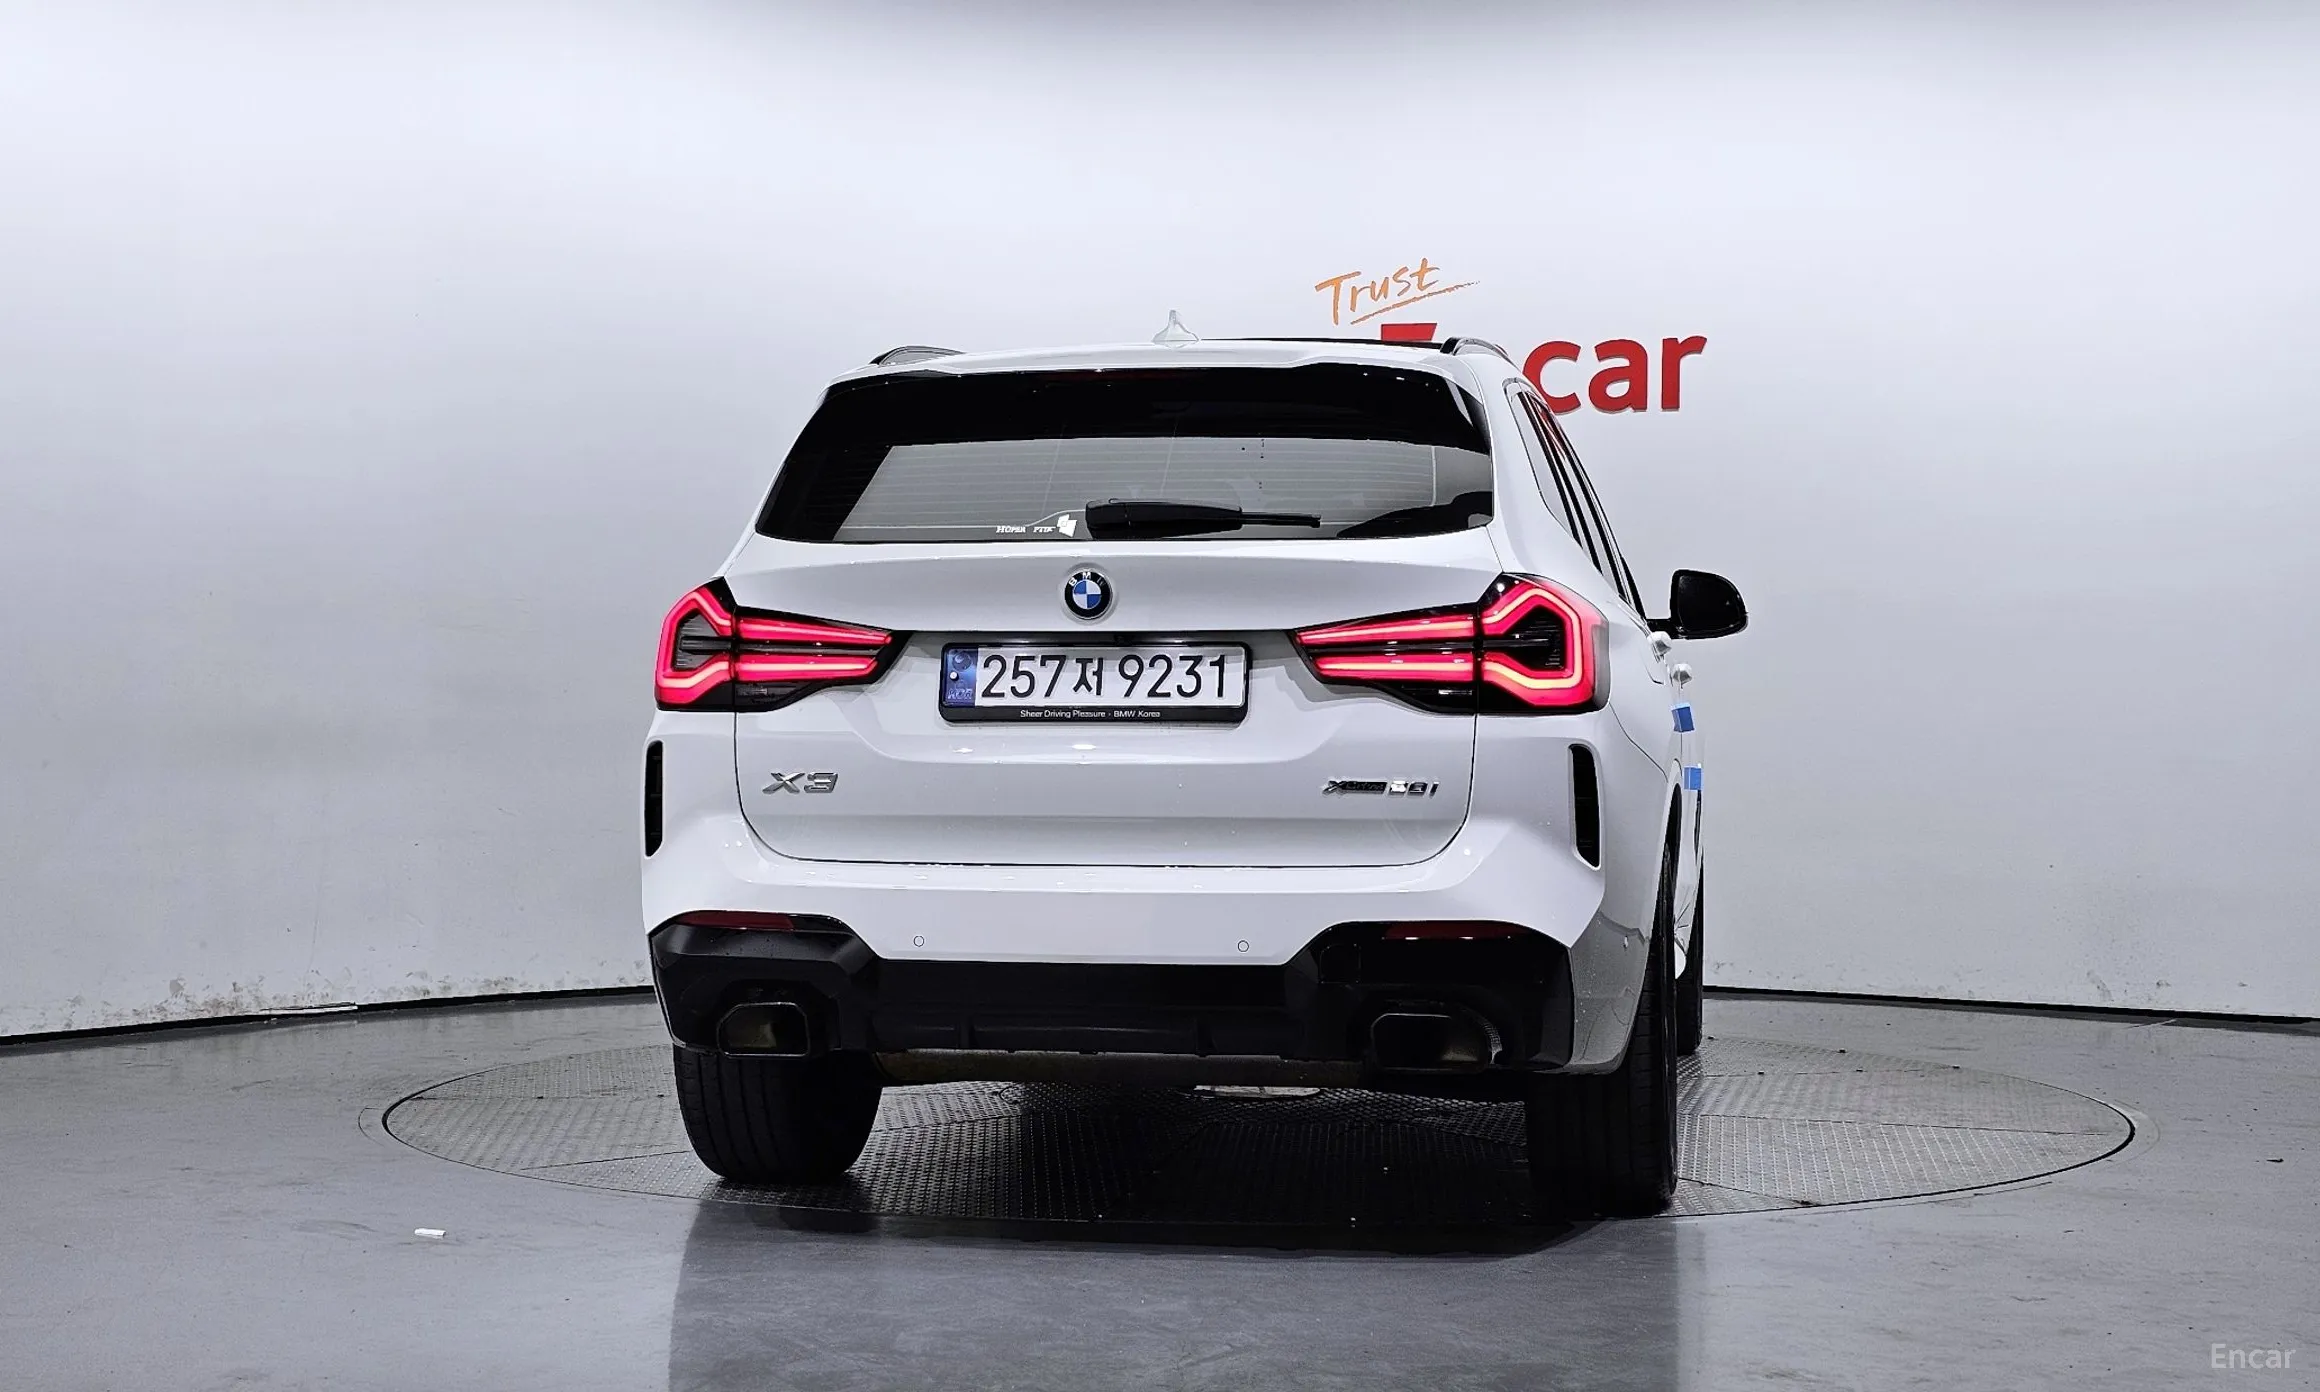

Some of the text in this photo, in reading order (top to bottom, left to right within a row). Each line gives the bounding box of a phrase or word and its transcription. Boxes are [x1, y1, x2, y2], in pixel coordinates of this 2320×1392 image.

[1315, 257, 1440, 326] Trust
[1380, 322, 1707, 415] car
[981, 654, 1225, 698] 257저 9231
[1020, 710, 1161, 719] Sheer Driving Pleasure BMW Korea
[762, 772, 838, 794] X3
